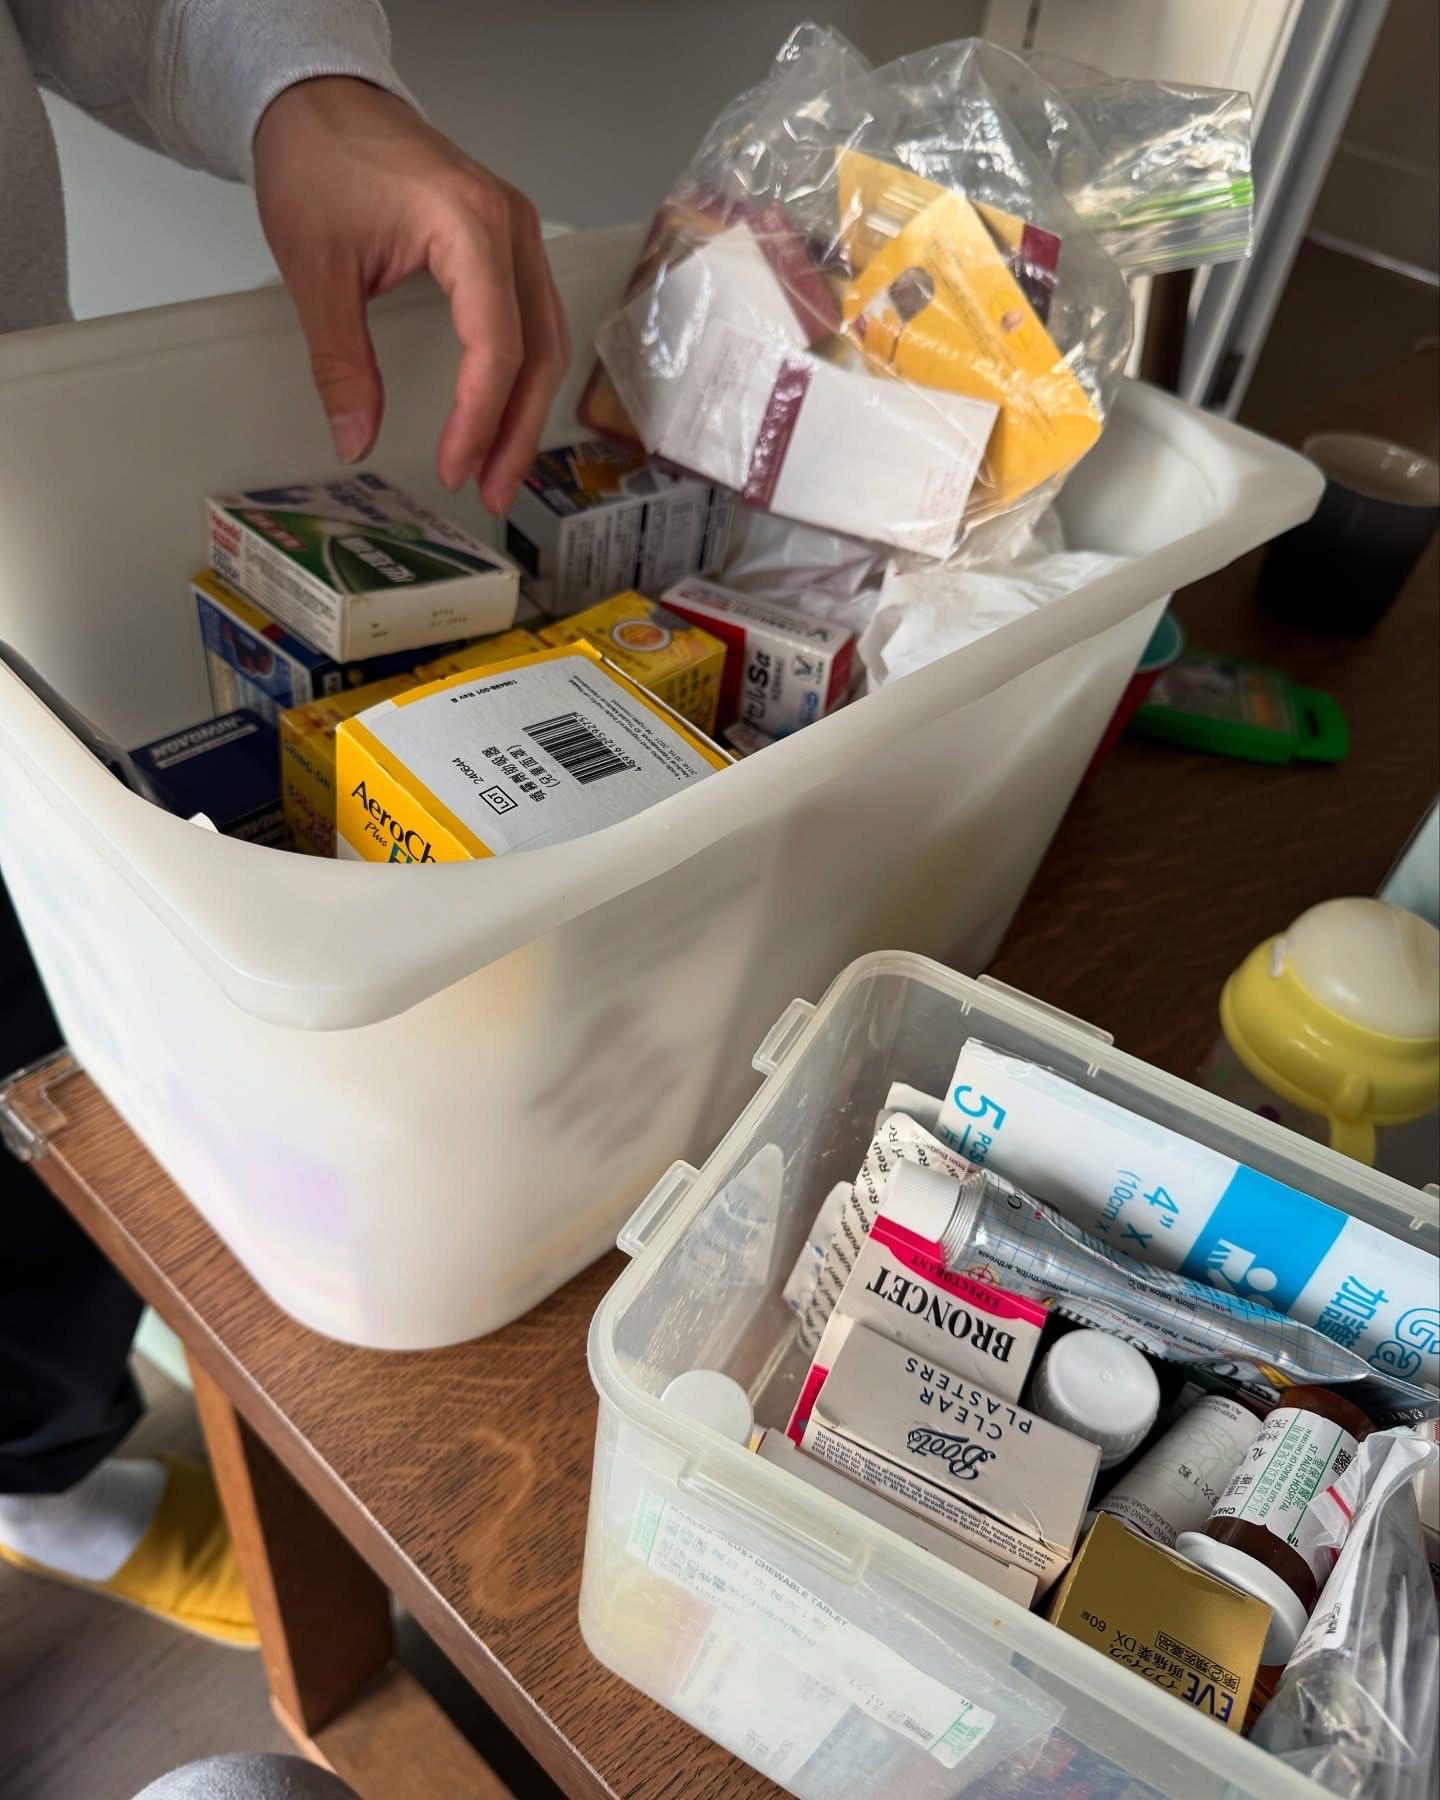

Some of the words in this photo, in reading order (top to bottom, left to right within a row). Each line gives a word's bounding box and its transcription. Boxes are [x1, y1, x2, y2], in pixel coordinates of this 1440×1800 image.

[452, 757, 484, 785] 240644
[487, 792, 510, 810] LOT
[365, 821, 389, 847] Plus
[953, 1084, 1007, 1131] 5
[1103, 1169, 1142, 1220] (10cm
[976, 1248, 1013, 1270] arthrosis
[1013, 1265, 1069, 1294] osteoarthritis,
[1147, 1285, 1173, 1302] below
[1172, 1295, 1197, 1311] Store
[866, 1265, 1016, 1363] BRONCET
[1142, 1320, 1160, 1332] and
[1159, 1326, 1179, 1339] Pain
[1180, 1335, 1216, 1352] Relieves
[905, 1357, 1033, 1435] PLASTERS
[919, 1386, 1003, 1440] CLEAR
[906, 1427, 996, 1480] Boots
[1288, 1454, 1298, 1463] OF
[1306, 1442, 1319, 1455] ST.
[1277, 1462, 1294, 1482] REACH
[1294, 1454, 1314, 1480] PAUL'S
[817, 1431, 835, 1445] Boots
[836, 1441, 853, 1454] Clear
[855, 1452, 881, 1470] Plasters
[882, 1467, 907, 1484] provide
[991, 1526, 1015, 1542] wounds
[1017, 1540, 1033, 1552] from
[1266, 1489, 1278, 1503] OUT
[1273, 1481, 1283, 1490] OF
[1276, 1477, 1302, 1513] HOSPITAL
[829, 1443, 840, 1452] and
[969, 1517, 980, 1527] aid
[980, 1525, 991, 1535] the
[993, 1532, 1017, 1549] healing
[1018, 1547, 1045, 1564] process
[1257, 1501, 1271, 1517] KEEP
[899, 1488, 917, 1501] Boots
[919, 1499, 945, 1516] plasters
[946, 1515, 958, 1523] are
[1034, 1561, 1046, 1570] are
[753, 1557, 810, 1599] CHEWABLE
[809, 1595, 850, 1628] TABLET
[1182, 1672, 1234, 1724] EVE
